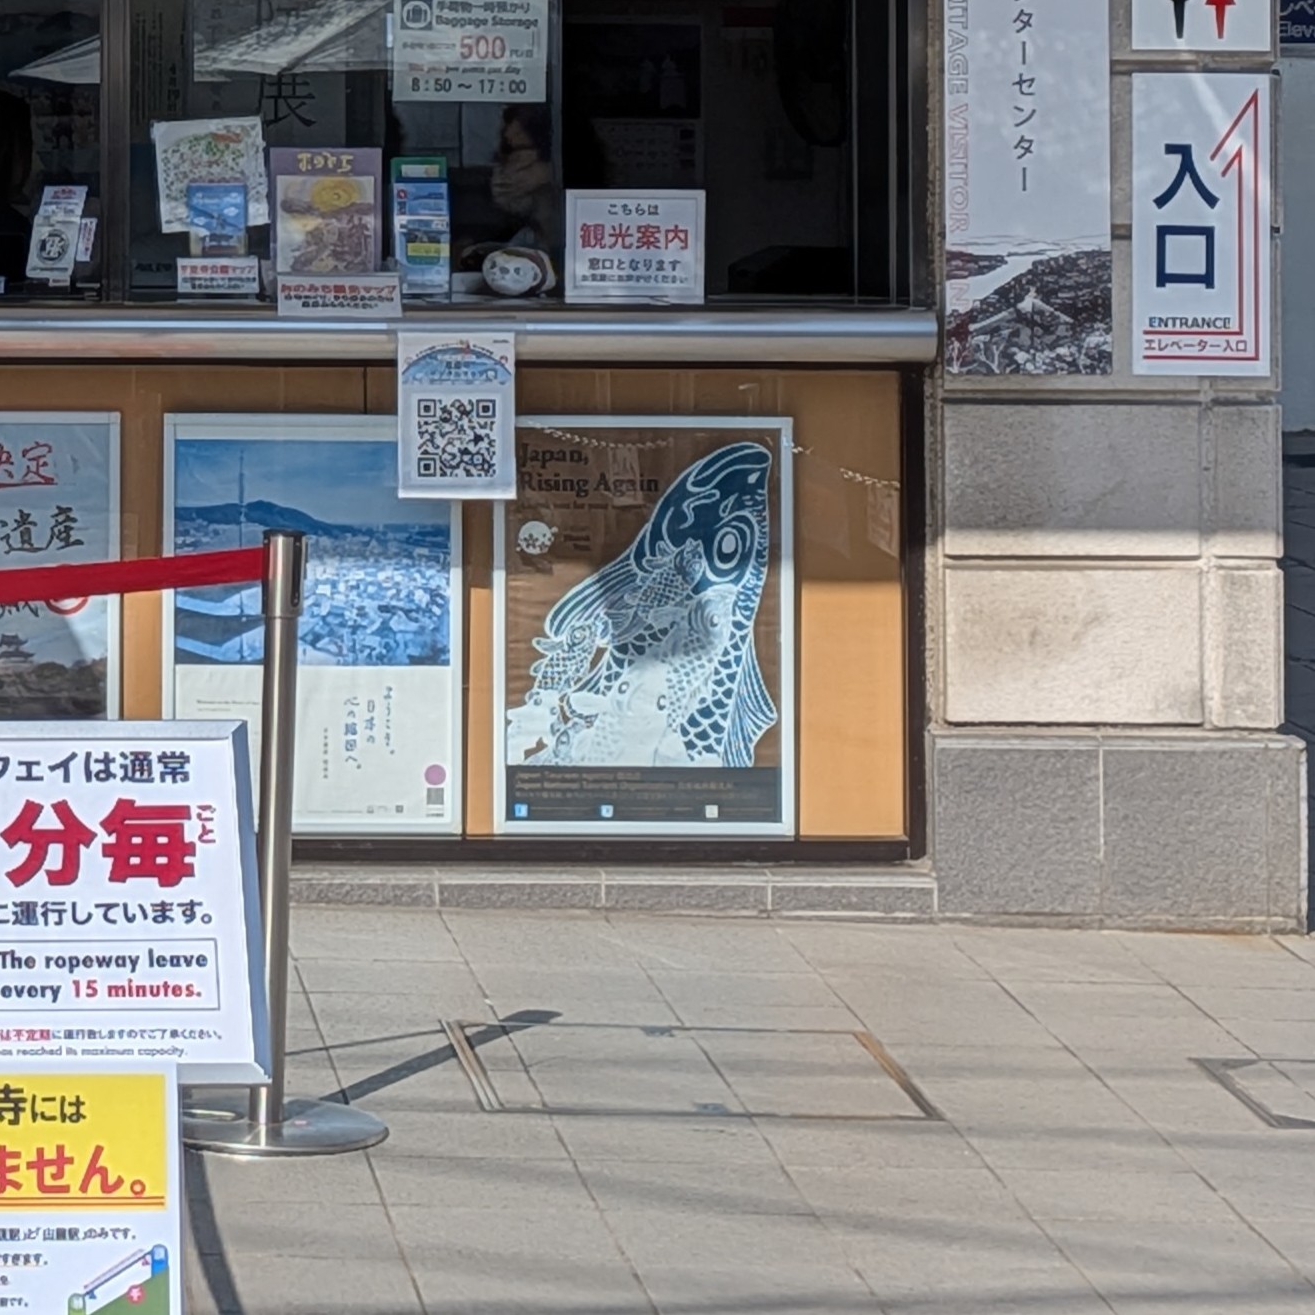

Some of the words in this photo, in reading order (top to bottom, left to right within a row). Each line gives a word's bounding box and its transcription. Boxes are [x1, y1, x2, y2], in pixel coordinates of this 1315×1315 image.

[435, 16, 489, 29] Baggage
[491, 15, 539, 29] Storage
[459, 35, 506, 60] 500
[478, 78, 527, 94] 17:00
[948, 103, 969, 234] VISITOR
[607, 203, 660, 216] こちらは
[1152, 143, 1220, 289] 入口
[579, 223, 689, 250] 観光案内
[587, 257, 682, 272] 窓口となります
[1148, 316, 1231, 329] ENTRANCE
[1144, 338, 1247, 353] エレベーター入口
[519, 471, 590, 498] Rising
[593, 472, 660, 497] Again
[197, 803, 218, 844] ごと
[44, 951, 140, 974] ropeway
[147, 948, 208, 969] leave
[0, 983, 62, 1004] every
[71, 979, 99, 999] 15
[107, 979, 203, 1000] minutes.
